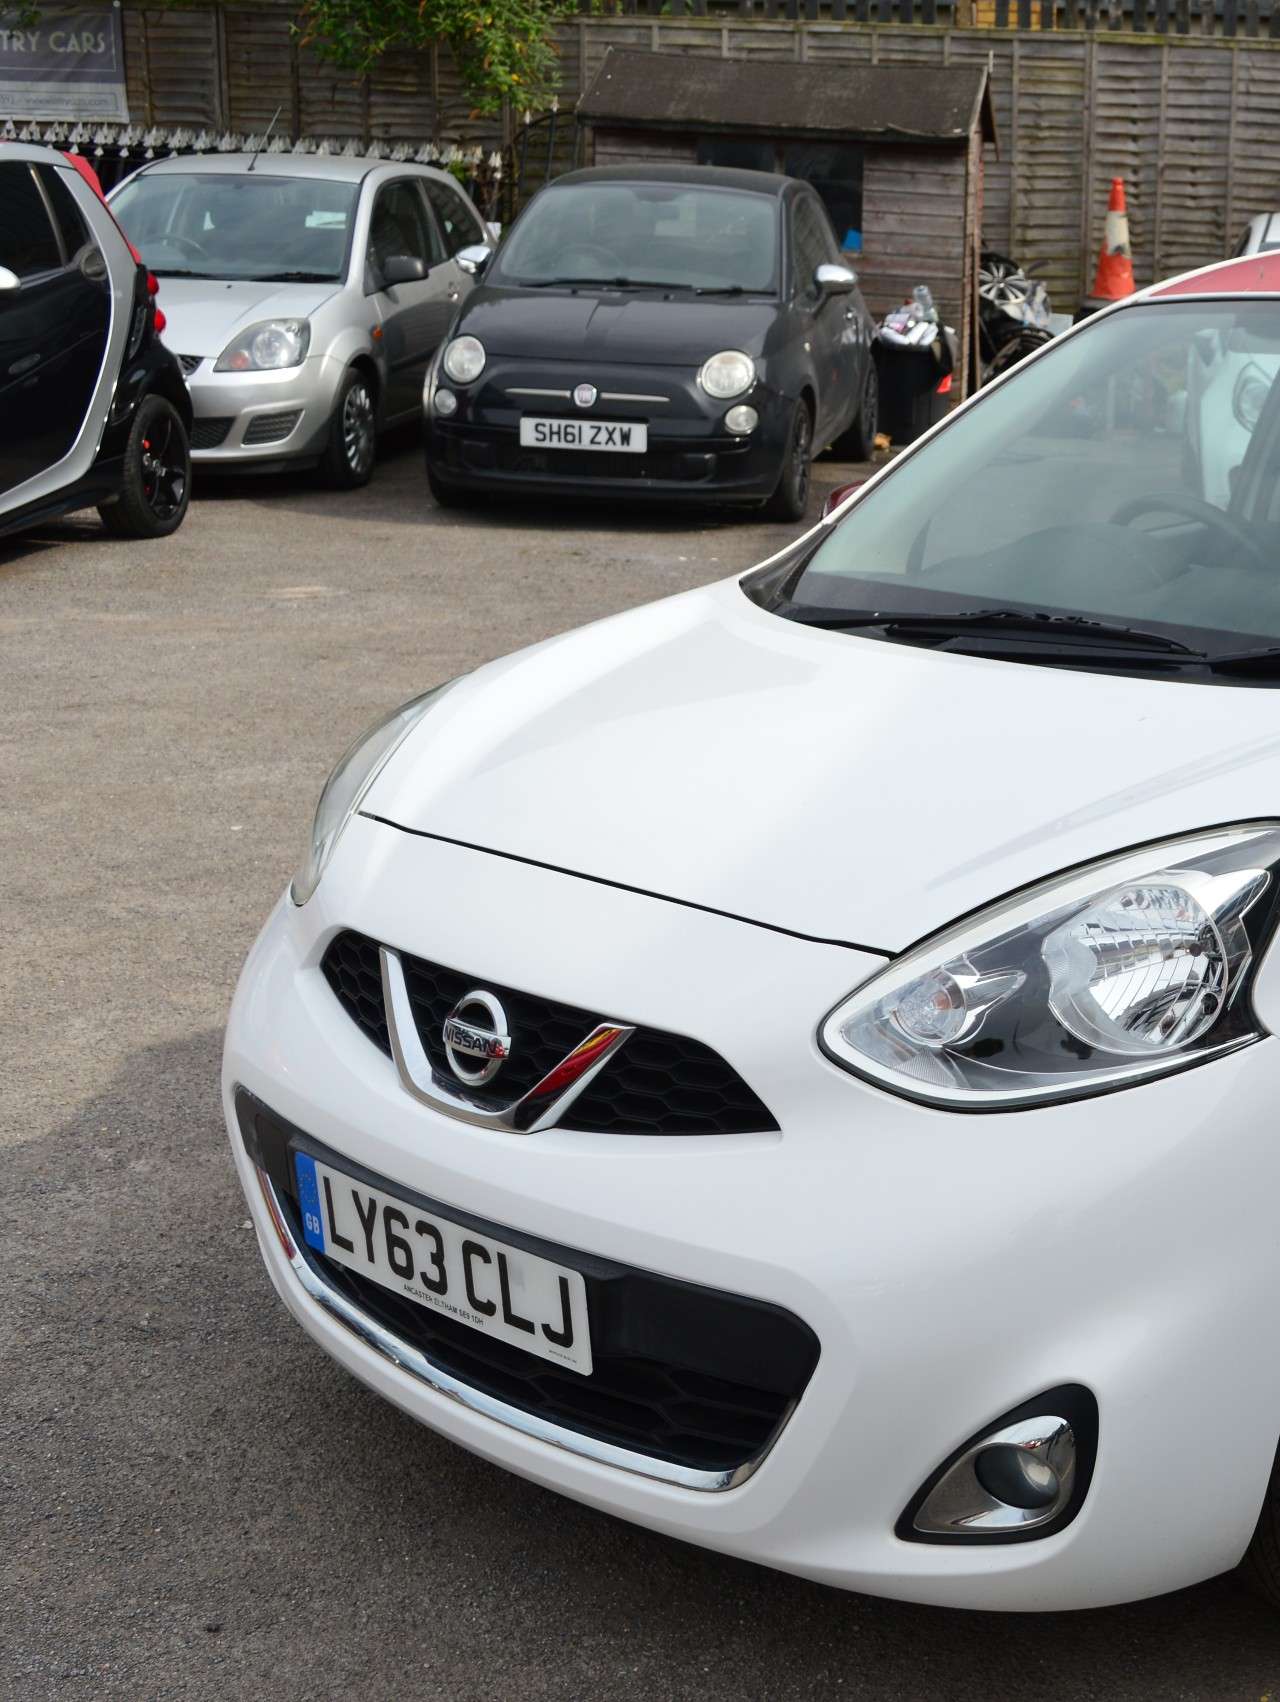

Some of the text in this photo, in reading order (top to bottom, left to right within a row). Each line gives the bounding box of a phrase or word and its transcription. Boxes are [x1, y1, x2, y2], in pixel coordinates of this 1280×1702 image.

[48, 31, 106, 54] CARS
[534, 423, 632, 447] SH61 ZXW
[445, 1023, 498, 1053] NISSAN
[304, 1211, 321, 1235] GB
[322, 1175, 575, 1349] LY63 CLJ
